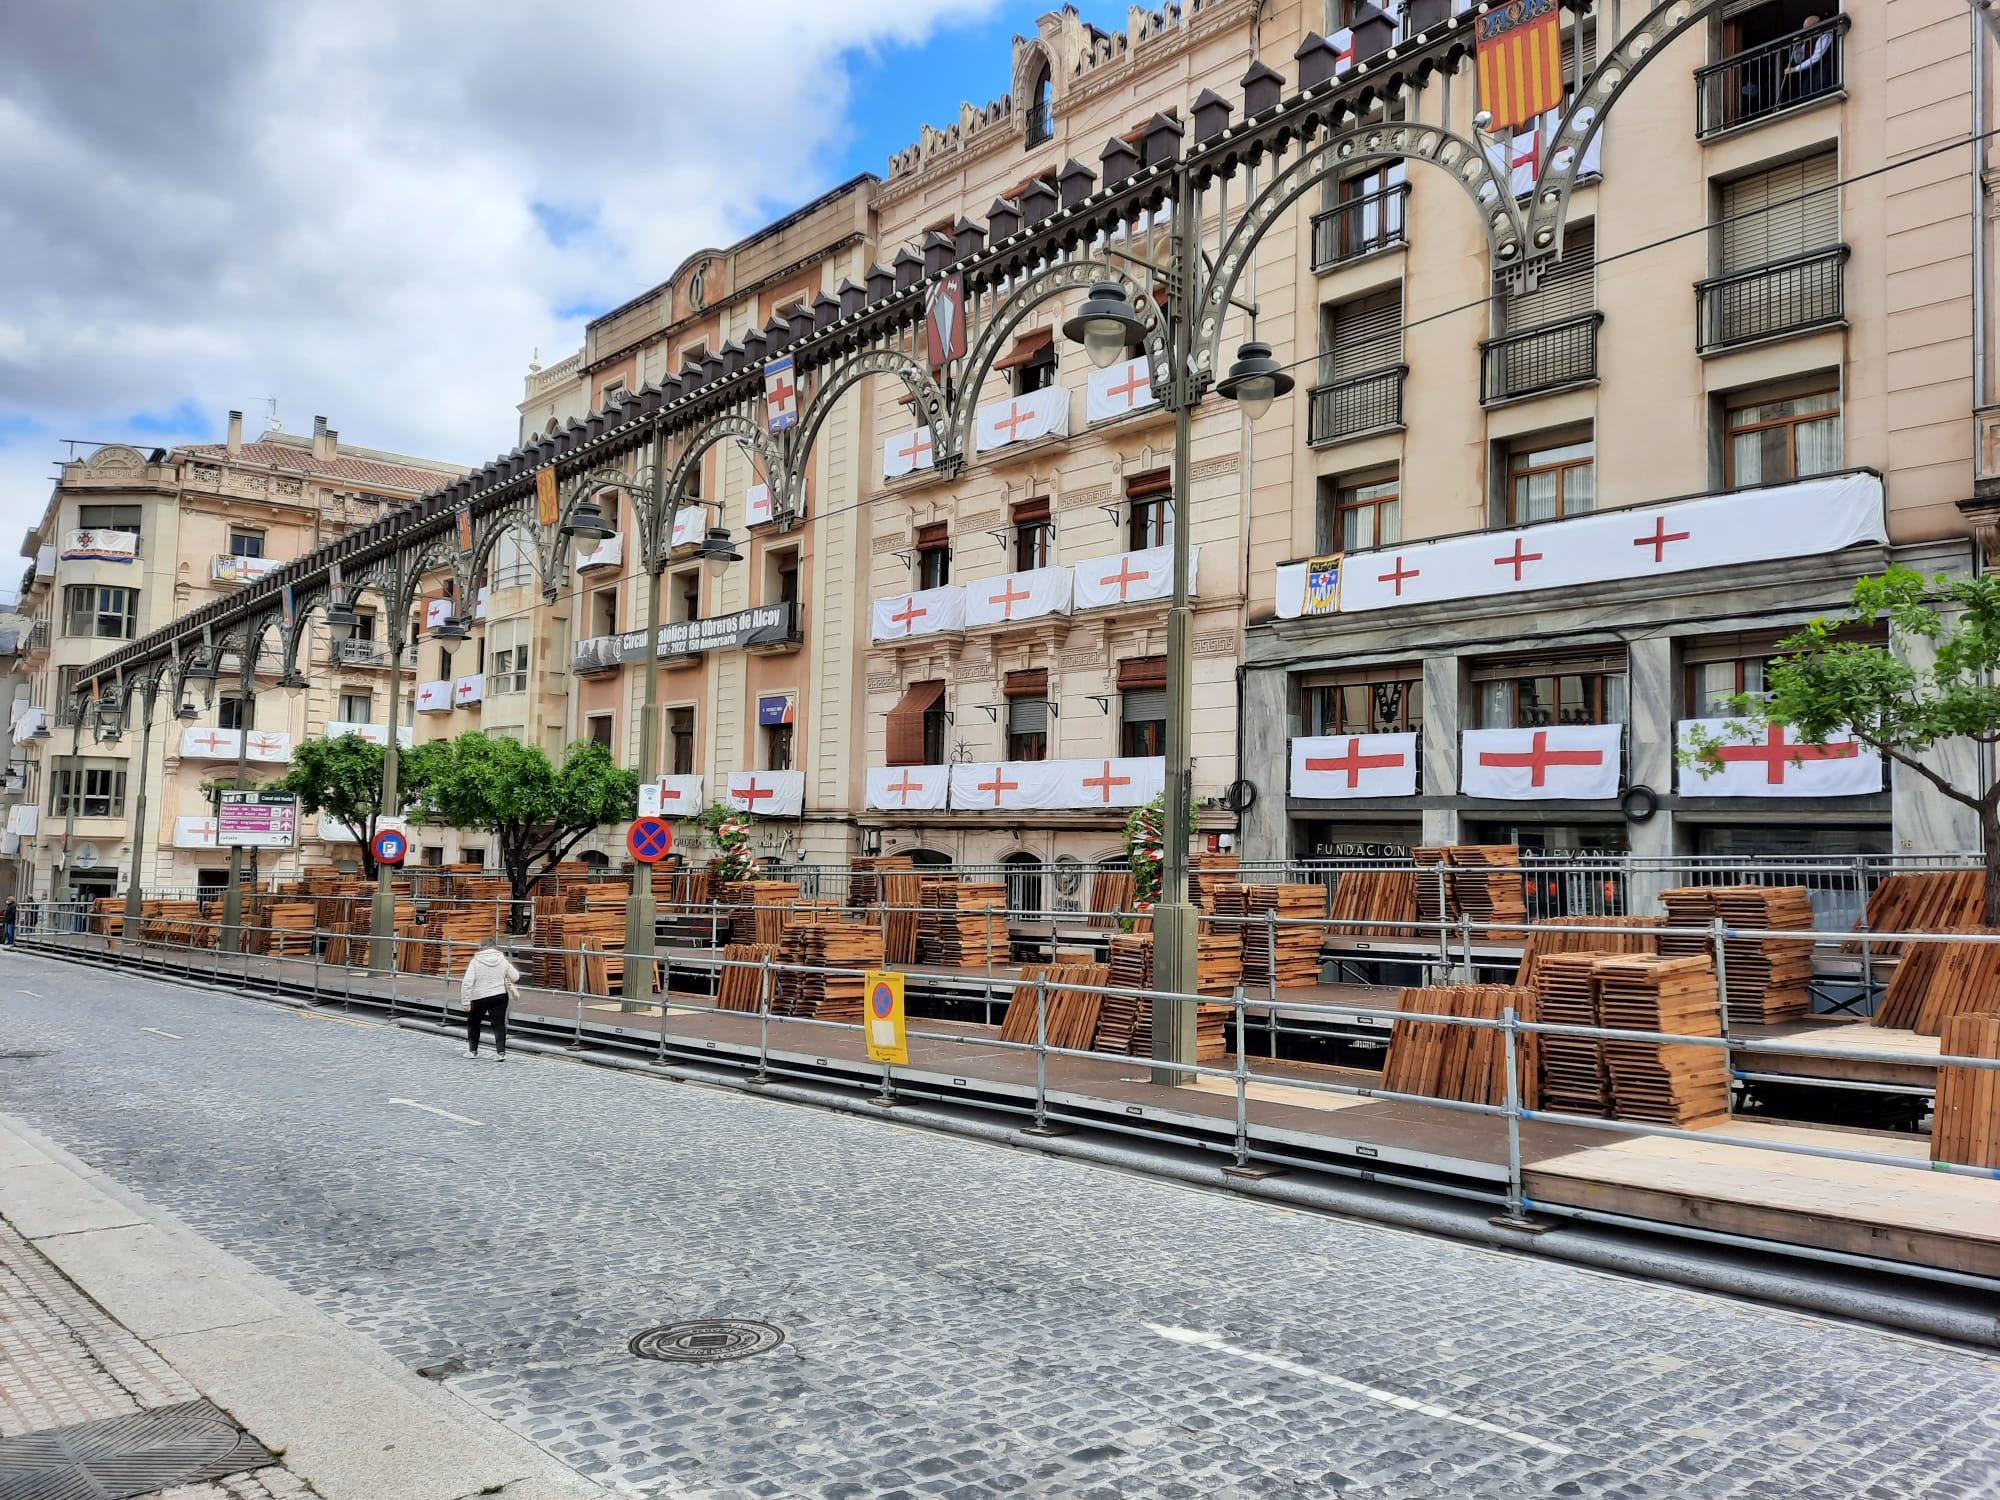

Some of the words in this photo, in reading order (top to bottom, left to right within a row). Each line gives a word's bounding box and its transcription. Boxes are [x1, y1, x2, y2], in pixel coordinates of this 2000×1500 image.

[623, 631, 648, 650] Círcul
[658, 625, 687, 643] atólico
[689, 622, 700, 638] de
[701, 617, 738, 637] Obreros
[738, 612, 751, 631] de
[752, 609, 781, 629] Alcoy
[657, 644, 667, 656] 872
[671, 641, 686, 653] 2022
[688, 639, 700, 651] 150
[700, 634, 737, 650] Aniversario
[385, 843, 394, 852] P
[1316, 842, 1405, 857] FUNDACIÓN
[1900, 839, 1913, 849] 16
